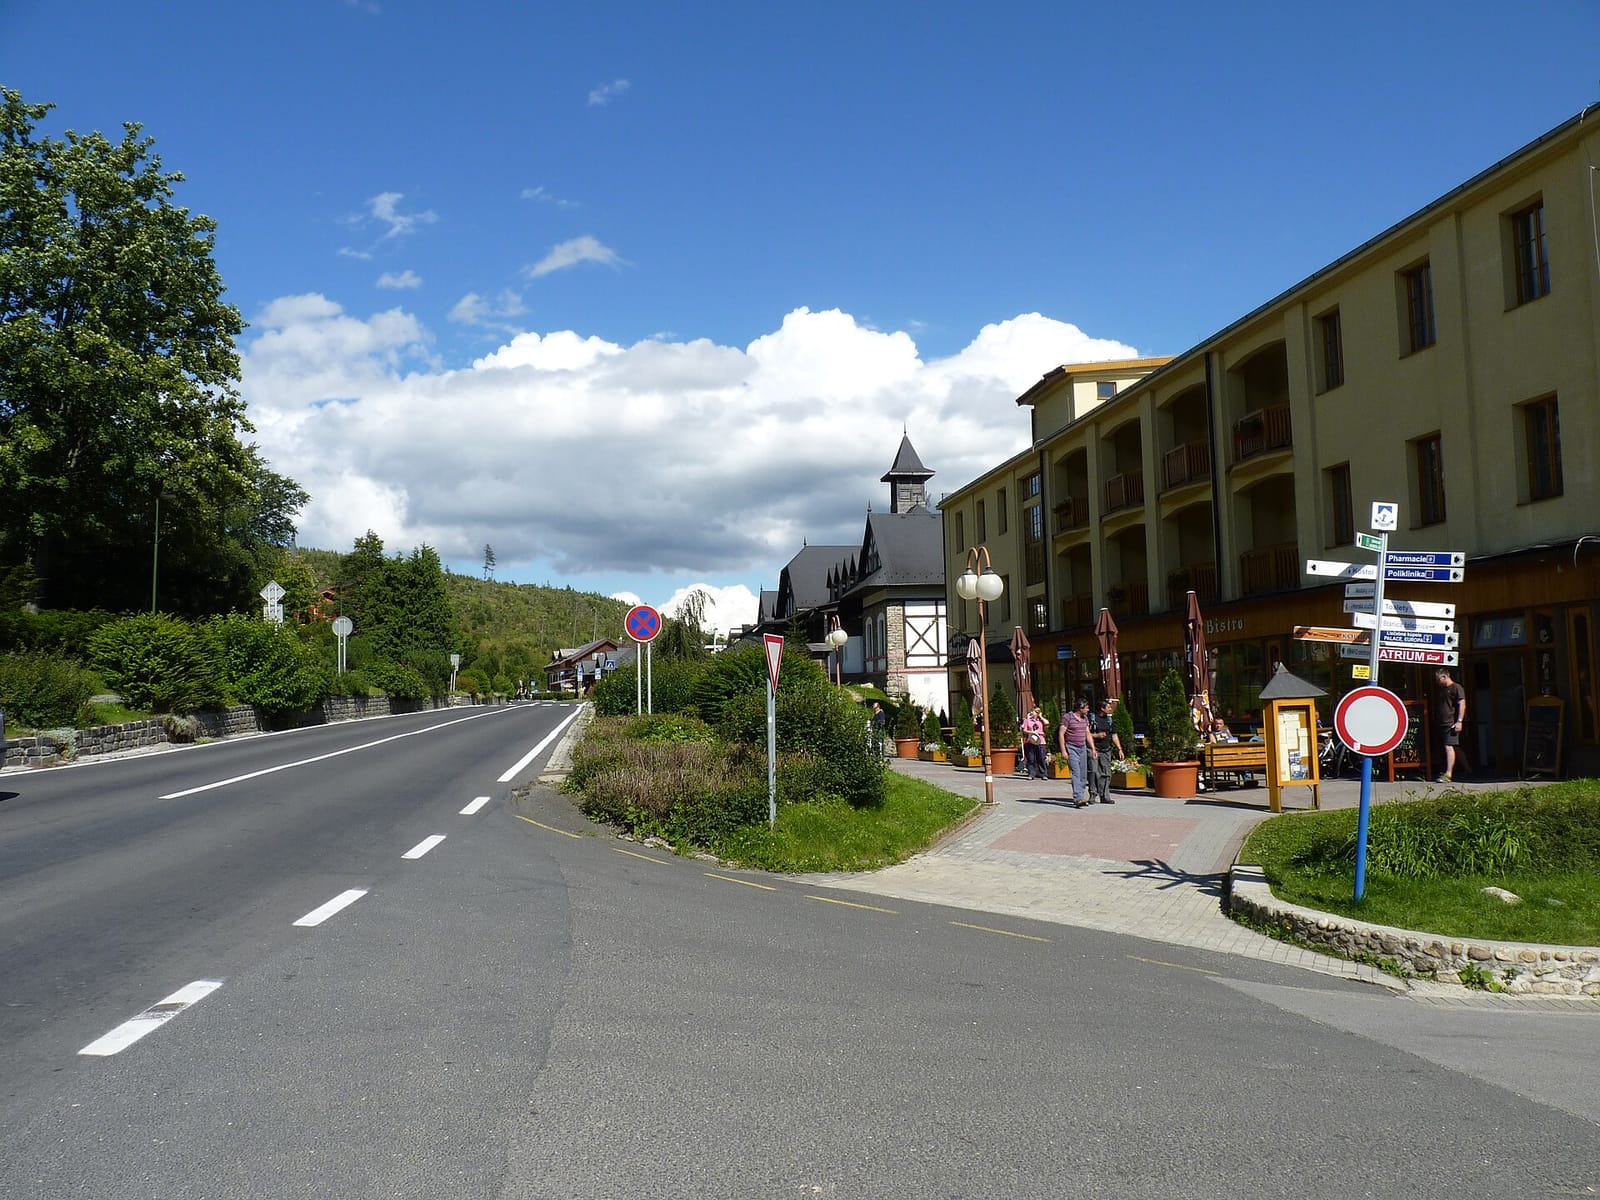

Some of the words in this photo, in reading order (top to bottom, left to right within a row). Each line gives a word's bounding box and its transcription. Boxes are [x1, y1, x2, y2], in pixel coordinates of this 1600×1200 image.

[1387, 554, 1427, 564] Pharmacie
[1387, 569, 1426, 578] Poliklinika
[1385, 603, 1409, 612] Toalety
[1206, 617, 1243, 634] Bistro
[1379, 649, 1425, 662] ATRIUM
